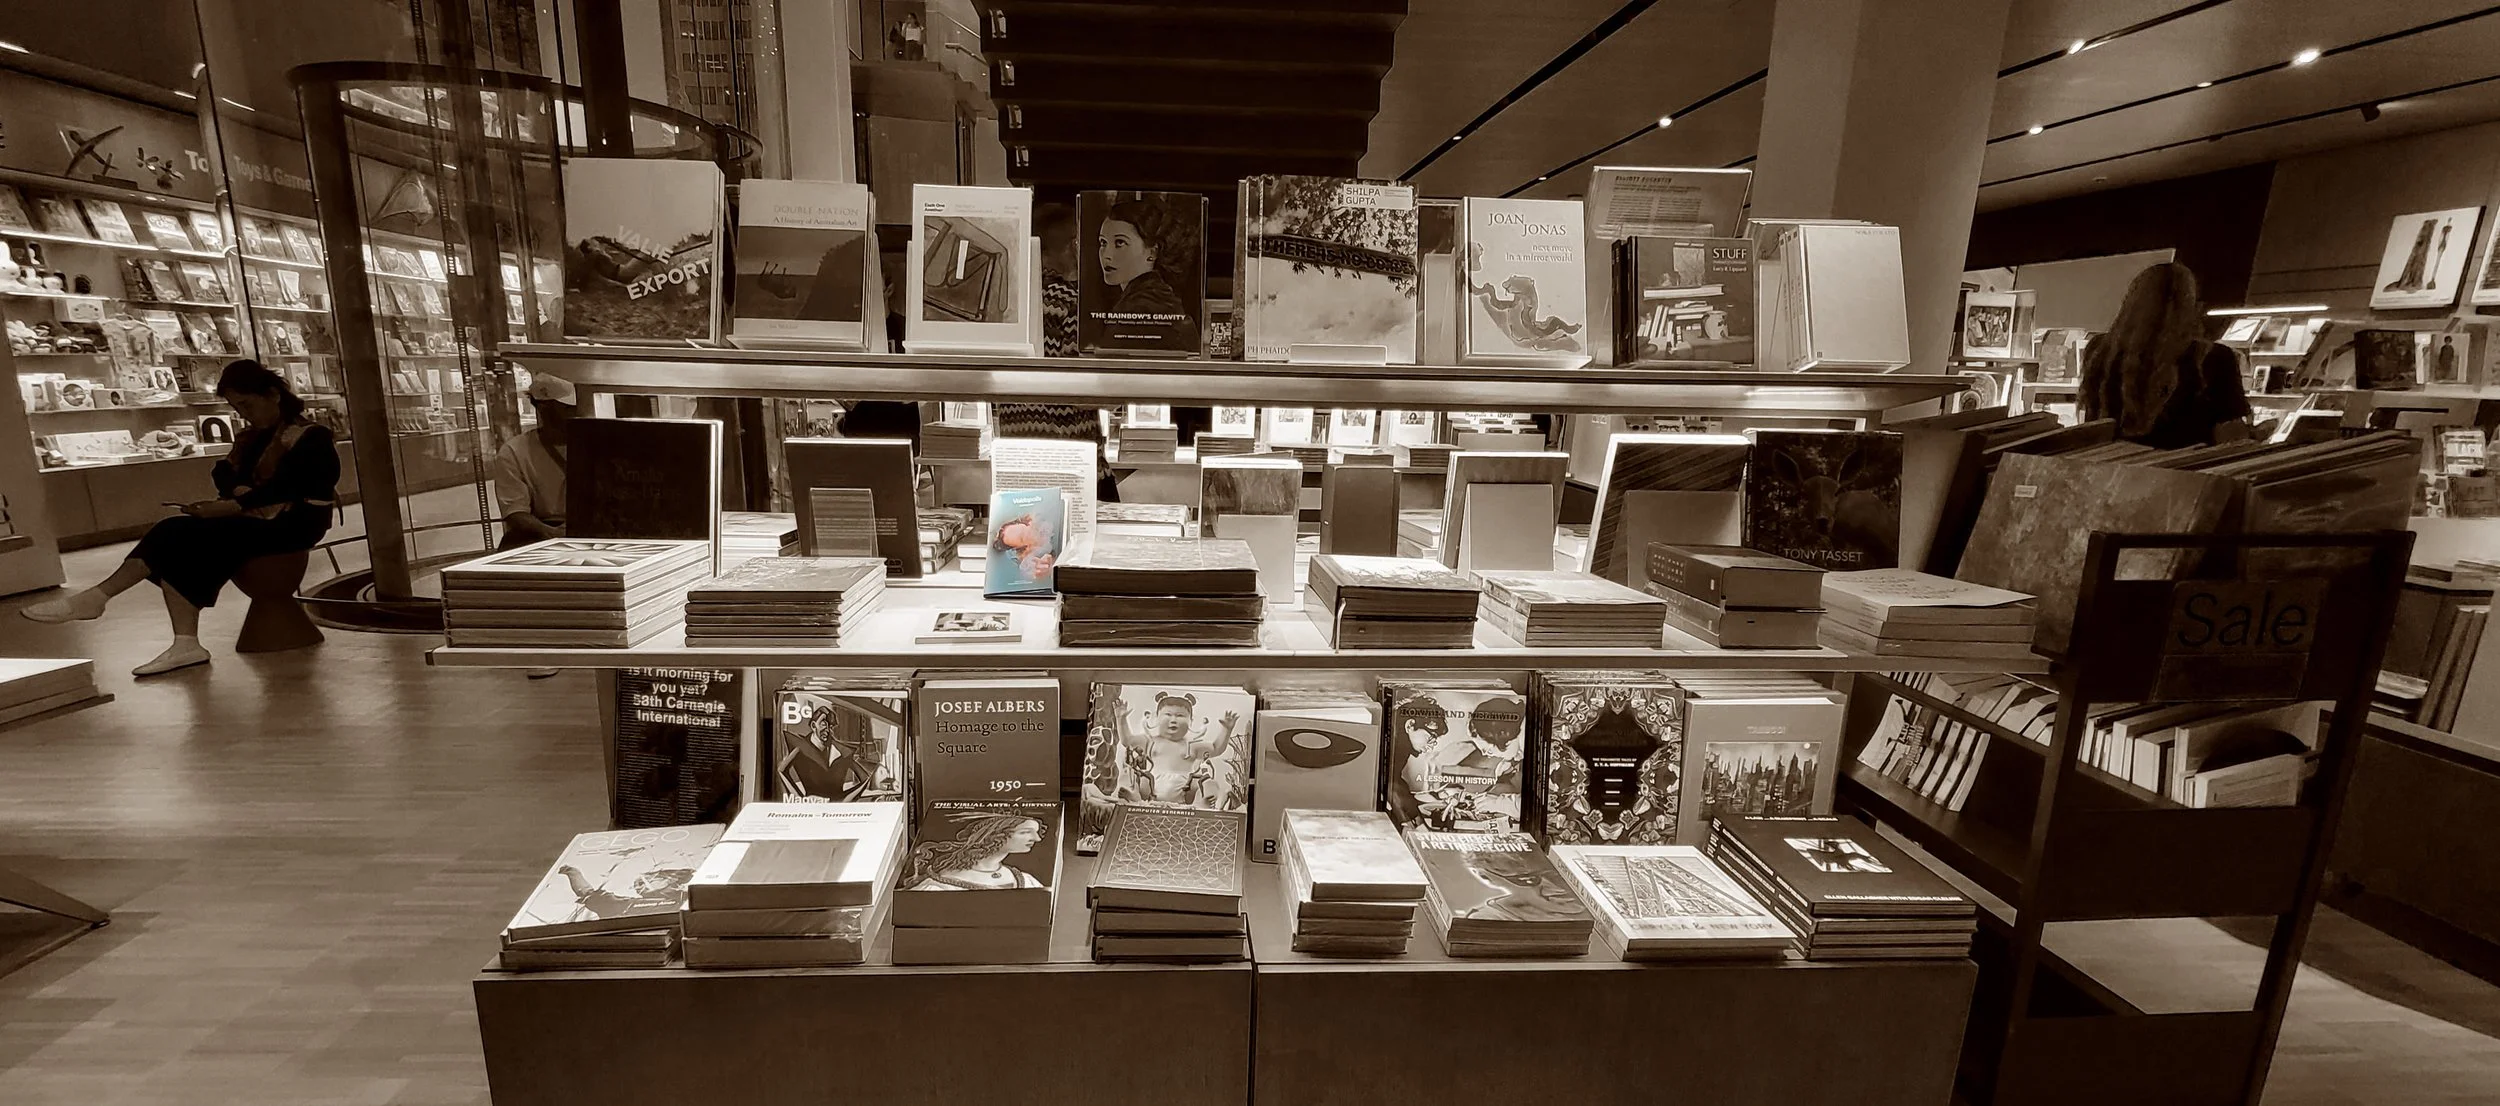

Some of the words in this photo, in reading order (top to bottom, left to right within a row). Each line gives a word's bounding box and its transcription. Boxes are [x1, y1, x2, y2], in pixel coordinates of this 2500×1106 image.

[184, 149, 209, 173] To
[234, 155, 262, 182] Toys
[262, 165, 272, 182] &
[273, 167, 312, 192] Game
[1346, 187, 1381, 197] SHILPA
[1345, 196, 1377, 206] GUPTA
[773, 204, 813, 215] DOUBLE
[818, 207, 859, 217] NATION
[1488, 213, 1525, 226] JOAN
[1521, 224, 1567, 237] JONAS
[619, 225, 674, 265] VALIE
[1532, 244, 1549, 252] next
[1522, 252, 1549, 262] mirror
[1550, 253, 1573, 262] world
[1712, 247, 1747, 259] STUFF
[626, 257, 710, 300] EXPORT
[1107, 312, 1152, 320] RAINBOW'S
[1152, 313, 1186, 321] GRAVITY
[1261, 346, 1290, 354] PHAIDO
[1783, 548, 1818, 560] TONY
[1819, 550, 1865, 562] TASSET
[2177, 590, 2308, 648] Sale
[656, 668, 711, 684] morning
[714, 669, 734, 682] for
[652, 683, 676, 694] you
[680, 684, 708, 697] yet?
[633, 693, 663, 707] 58th
[666, 697, 726, 714] Carnegie
[934, 701, 983, 717] JOSEF
[985, 700, 1045, 713] ALBERS
[637, 709, 721, 728] International
[1445, 710, 1466, 719] AND
[935, 720, 998, 737] Homage
[1002, 722, 1017, 732] to
[1021, 718, 1045, 732] the
[937, 741, 987, 758] Square
[989, 780, 1022, 792] 1950
[1416, 774, 1422, 782] A
[1424, 775, 1454, 783] LESSON
[1455, 775, 1464, 784] IN
[1465, 776, 1498, 785] HISTORY
[580, 829, 690, 849] GEGO
[1420, 841, 1430, 850] A
[1431, 841, 1533, 852] RETROSPECTIVE
[1630, 922, 1689, 931] CHRYSSA
[1693, 922, 1705, 930] &
[1709, 922, 1739, 930] NEW
[1743, 922, 1775, 930] YORK
